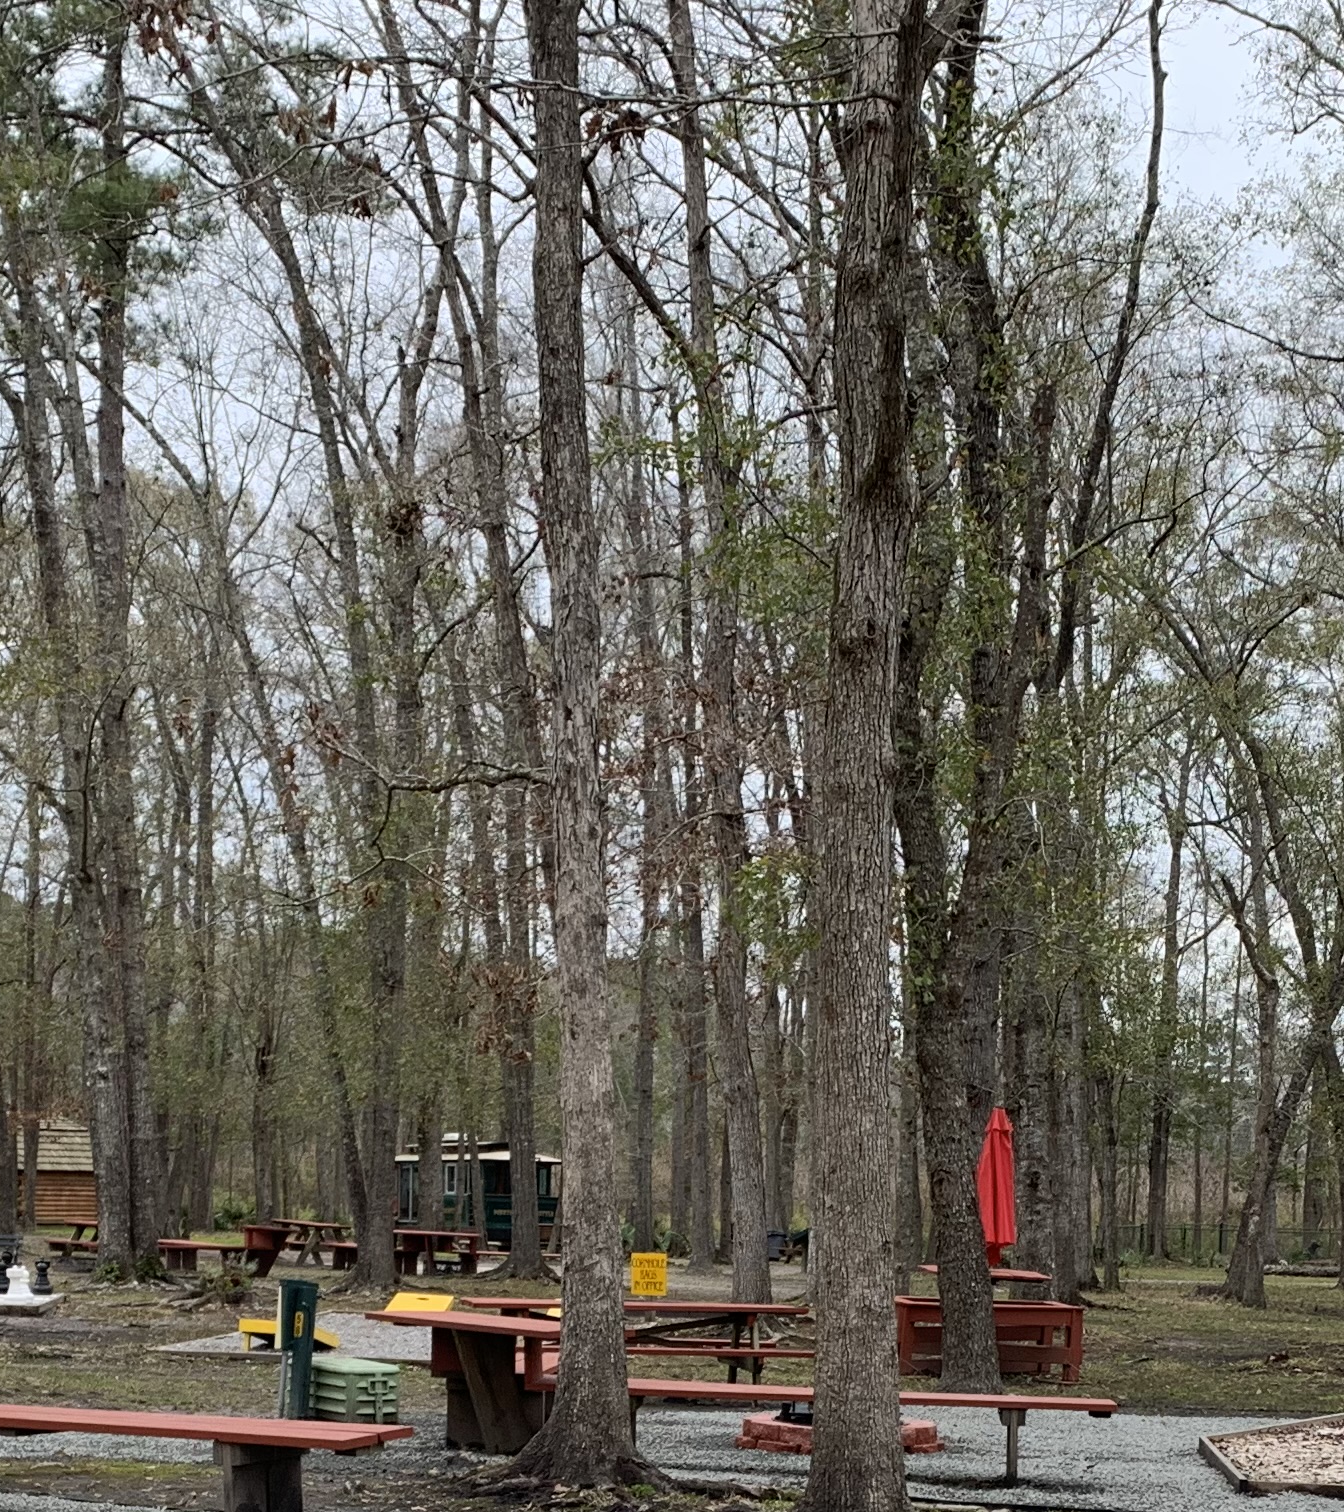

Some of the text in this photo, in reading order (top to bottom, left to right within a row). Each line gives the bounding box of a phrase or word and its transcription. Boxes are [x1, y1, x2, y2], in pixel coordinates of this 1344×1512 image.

[632, 1258, 665, 1268] CORNHOLE
[640, 1269, 657, 1280] BAGS
[634, 1281, 663, 1291] IN OFFICE
